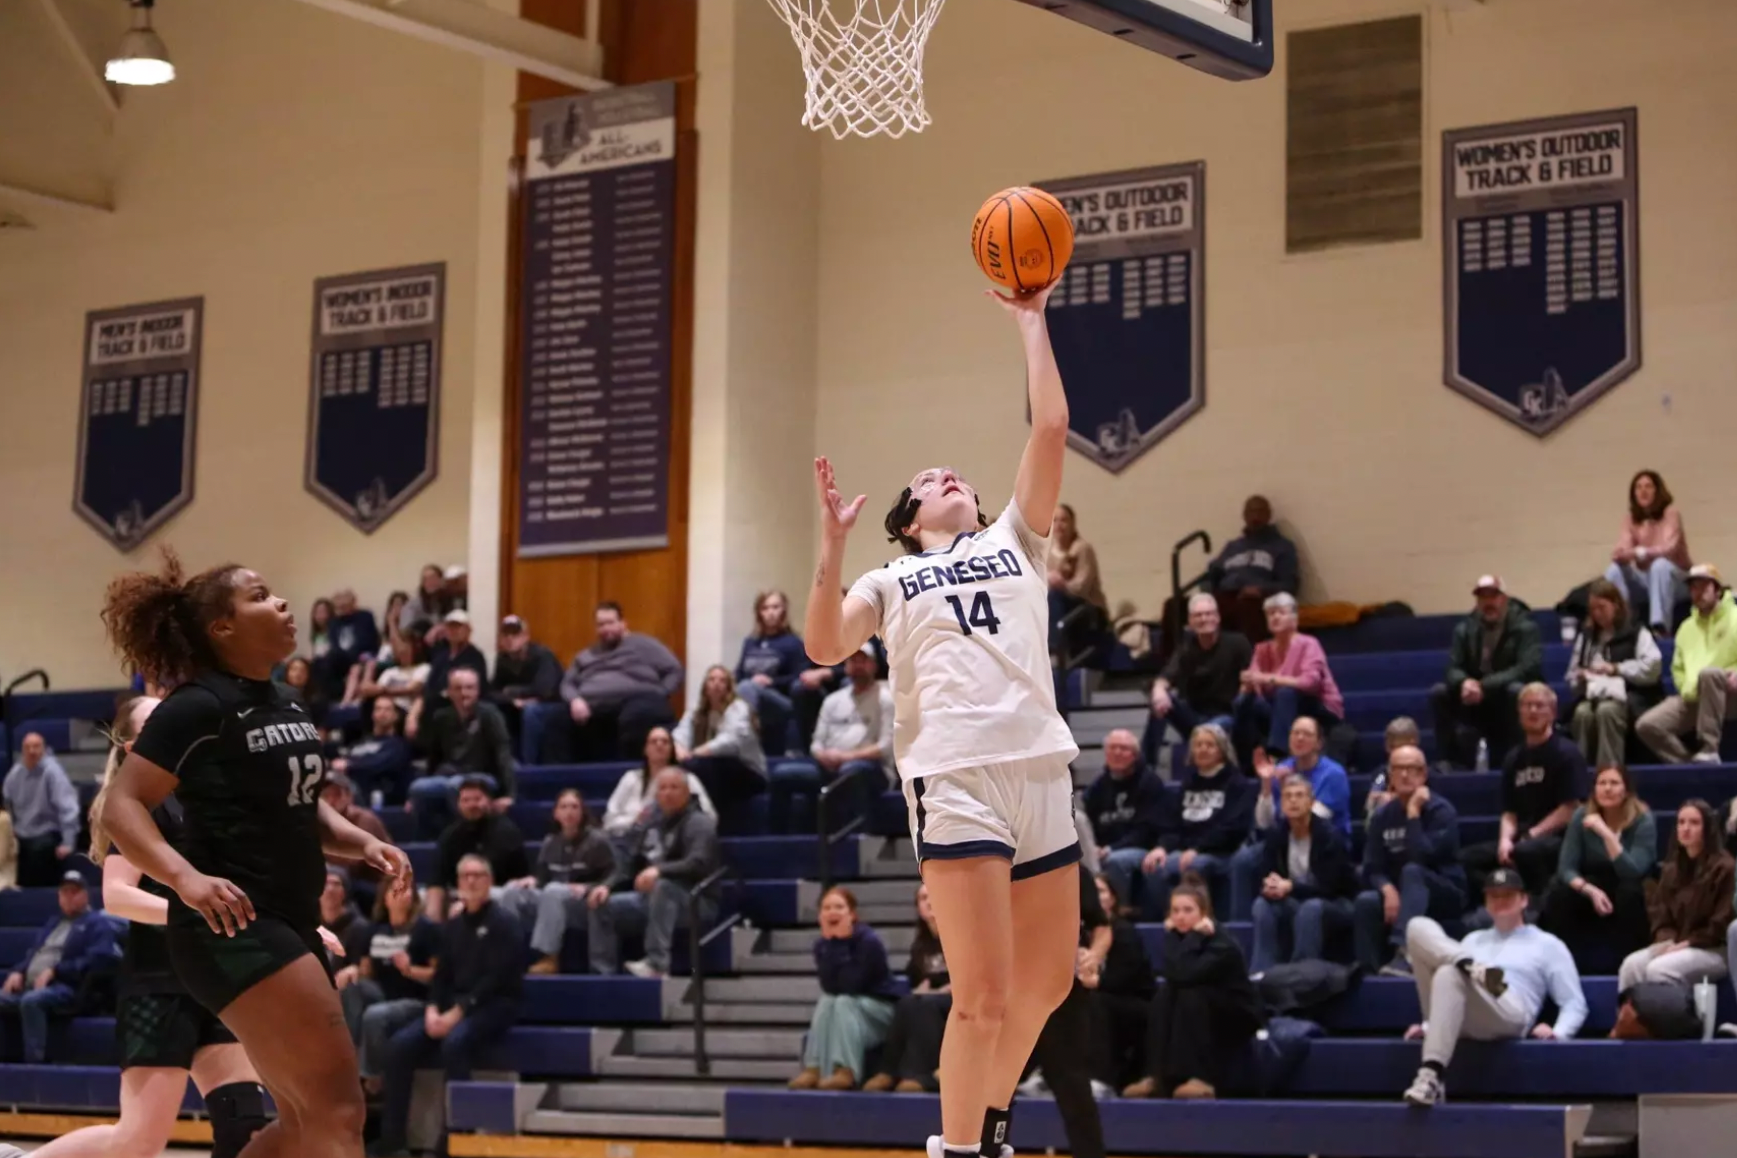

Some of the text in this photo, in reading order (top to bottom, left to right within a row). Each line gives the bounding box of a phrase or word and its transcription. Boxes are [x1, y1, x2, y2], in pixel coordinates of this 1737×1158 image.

[1458, 129, 1621, 167] WOMEN'S OUTDOOR
[1466, 164, 1532, 190] TRACK
[1558, 154, 1613, 180] FIELD
[1059, 182, 1188, 214] EN'S OUTDOOR
[1074, 213, 1111, 236] ACK
[1134, 205, 1183, 230] FIELD
[329, 306, 373, 329] TRACK
[391, 300, 428, 322] FIELD
[99, 339, 135, 358] TRACK
[899, 549, 1022, 602] GENESEO
[944, 591, 1001, 636] 14
[287, 754, 322, 807] 12
